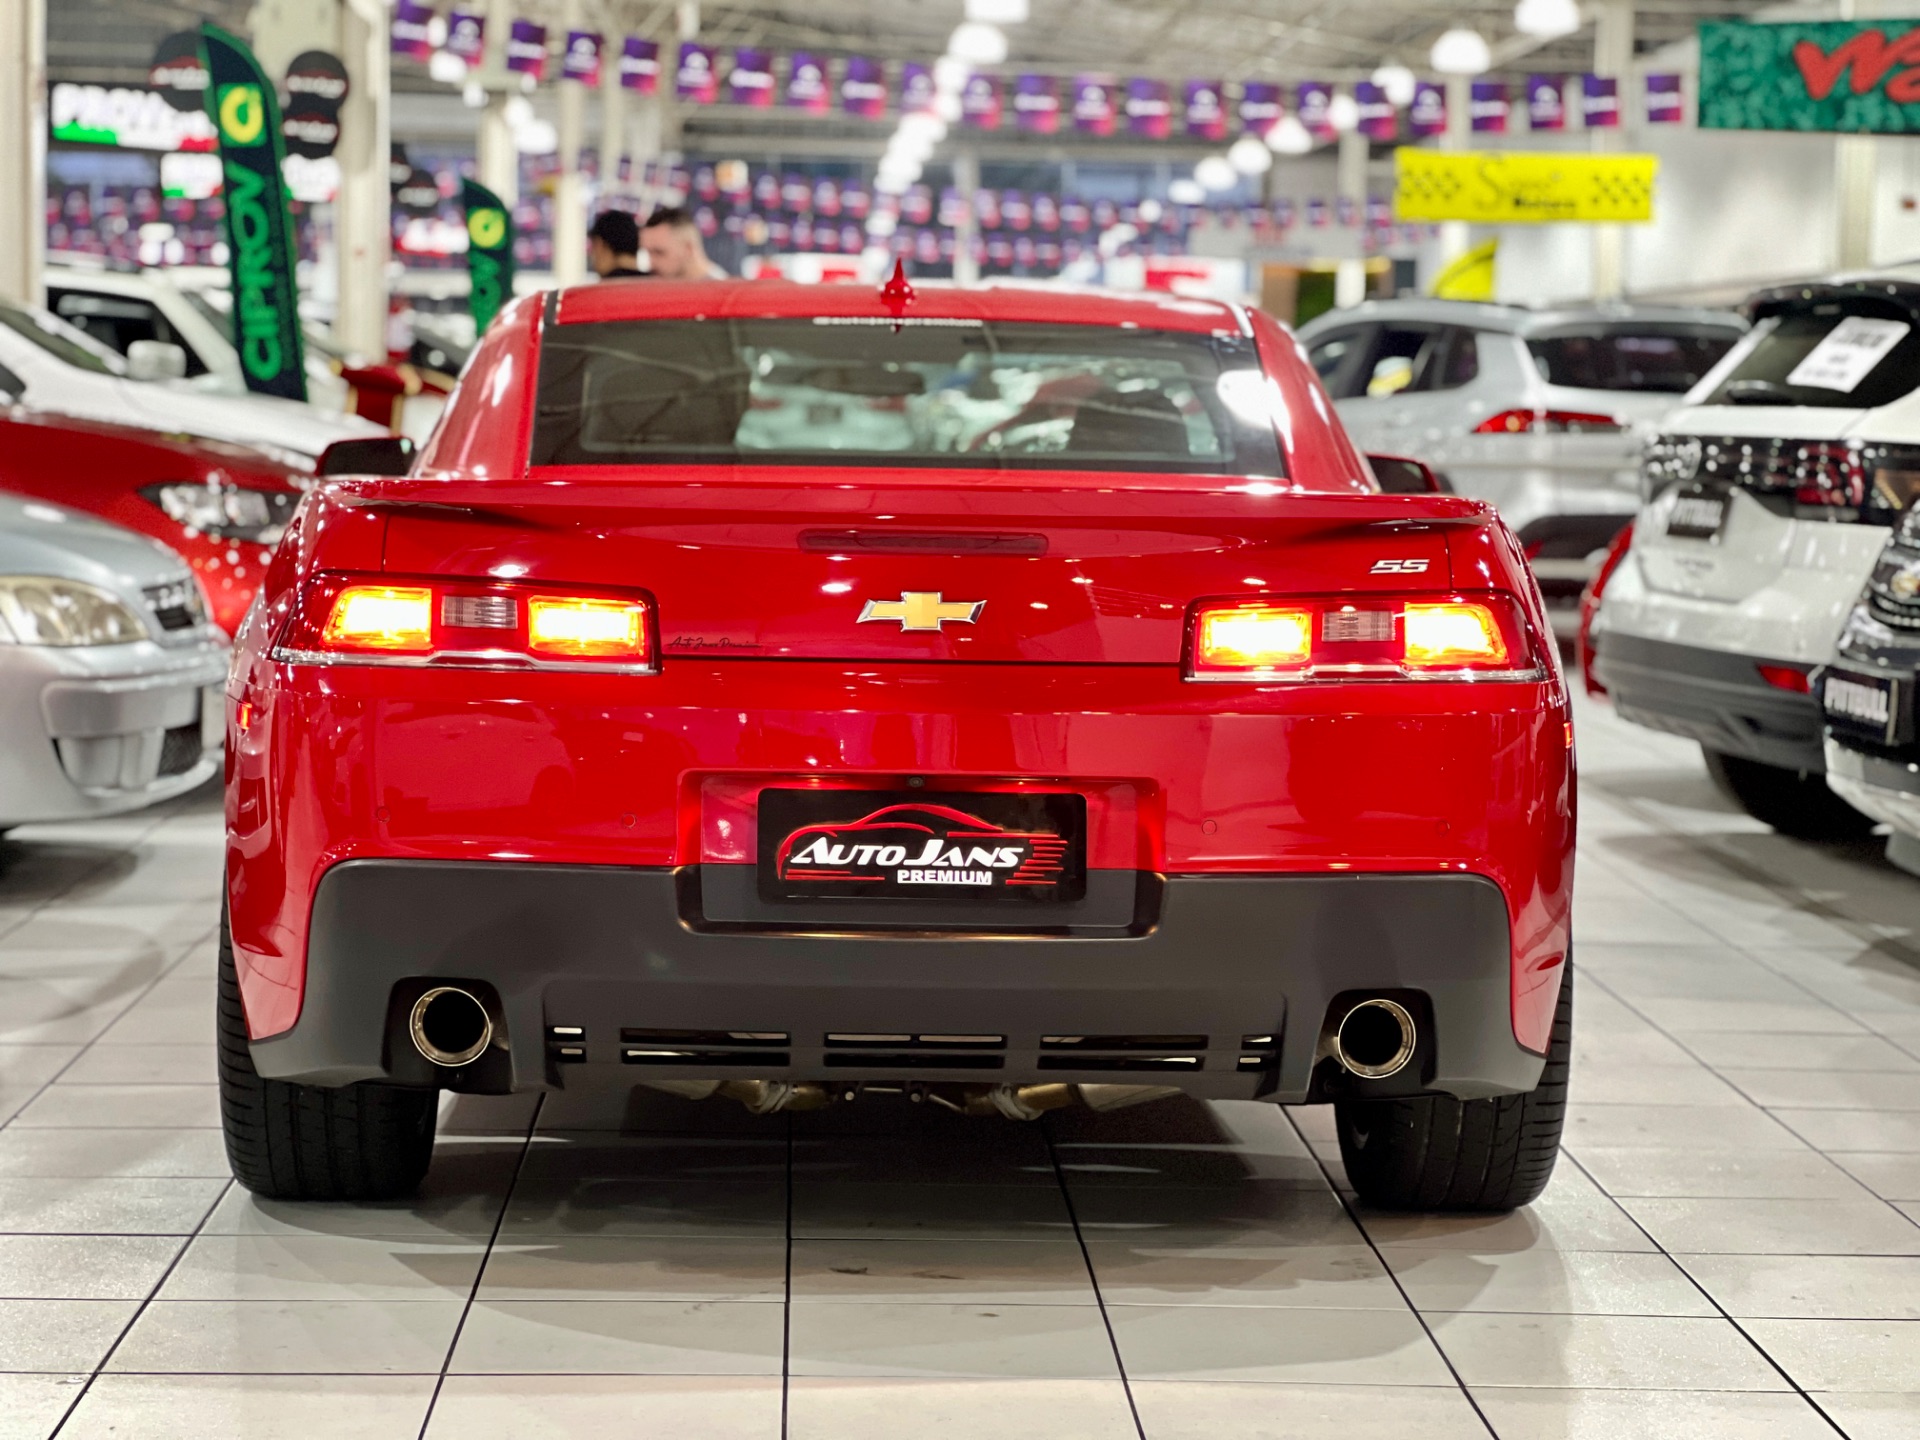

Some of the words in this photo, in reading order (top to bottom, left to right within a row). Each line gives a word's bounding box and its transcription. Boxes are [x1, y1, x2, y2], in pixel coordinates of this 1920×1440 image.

[225, 160, 282, 381] CIPROV
[1368, 559, 1430, 574] SS
[790, 836, 907, 866] AUTO
[904, 839, 1024, 868] JANS
[898, 869, 992, 885] PREMIUM
